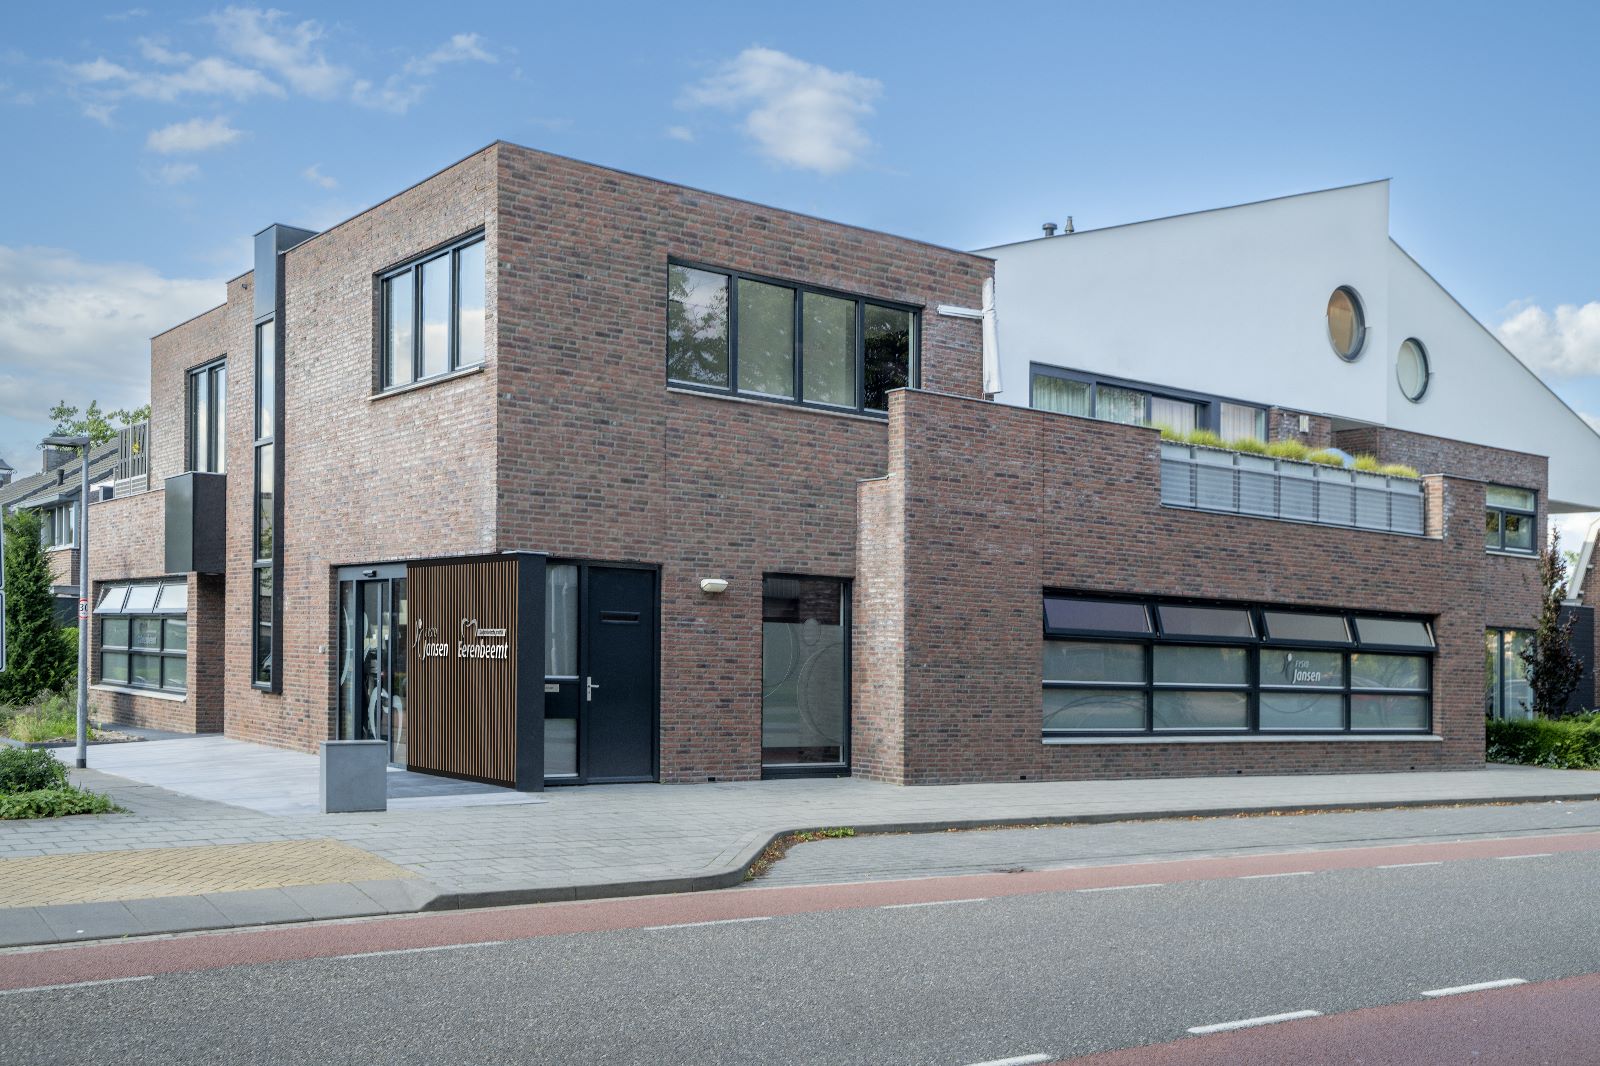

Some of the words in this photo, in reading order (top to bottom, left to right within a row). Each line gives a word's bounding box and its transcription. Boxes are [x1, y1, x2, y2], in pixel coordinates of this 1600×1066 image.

[422, 639, 448, 660] Jansen
[458, 639, 508, 659] Eerenbeemt
[1292, 669, 1321, 684] Jansen
